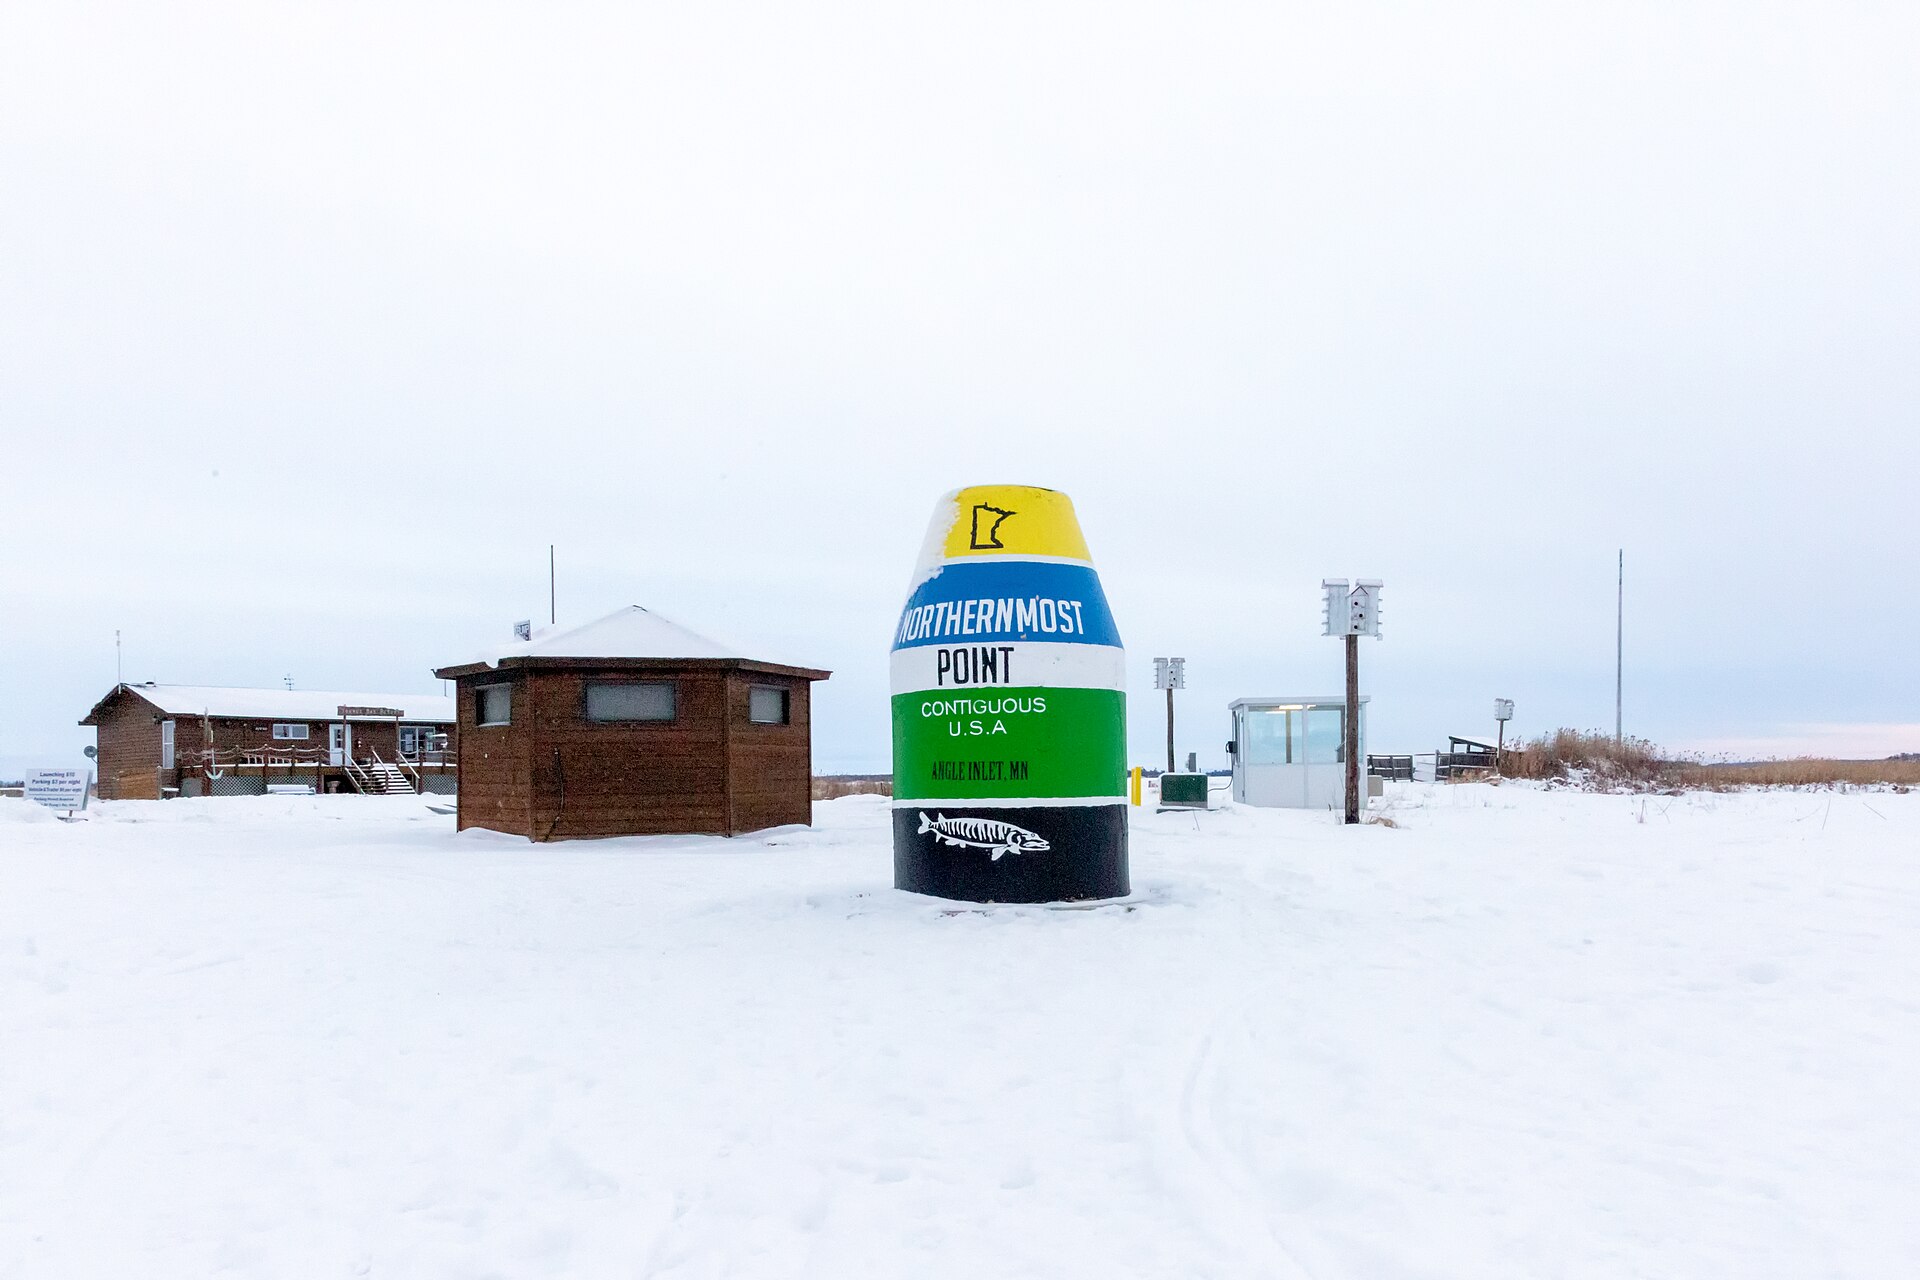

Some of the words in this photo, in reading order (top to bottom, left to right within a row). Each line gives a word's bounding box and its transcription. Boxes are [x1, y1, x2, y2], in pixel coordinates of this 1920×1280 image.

[899, 598, 1084, 643] NORTHERNMOST
[938, 647, 1014, 685] POINT
[921, 697, 1046, 717] CONTIGUOUS
[949, 720, 1007, 736] U.S.A
[932, 761, 965, 780] ANGLE
[1010, 761, 1028, 780] MN
